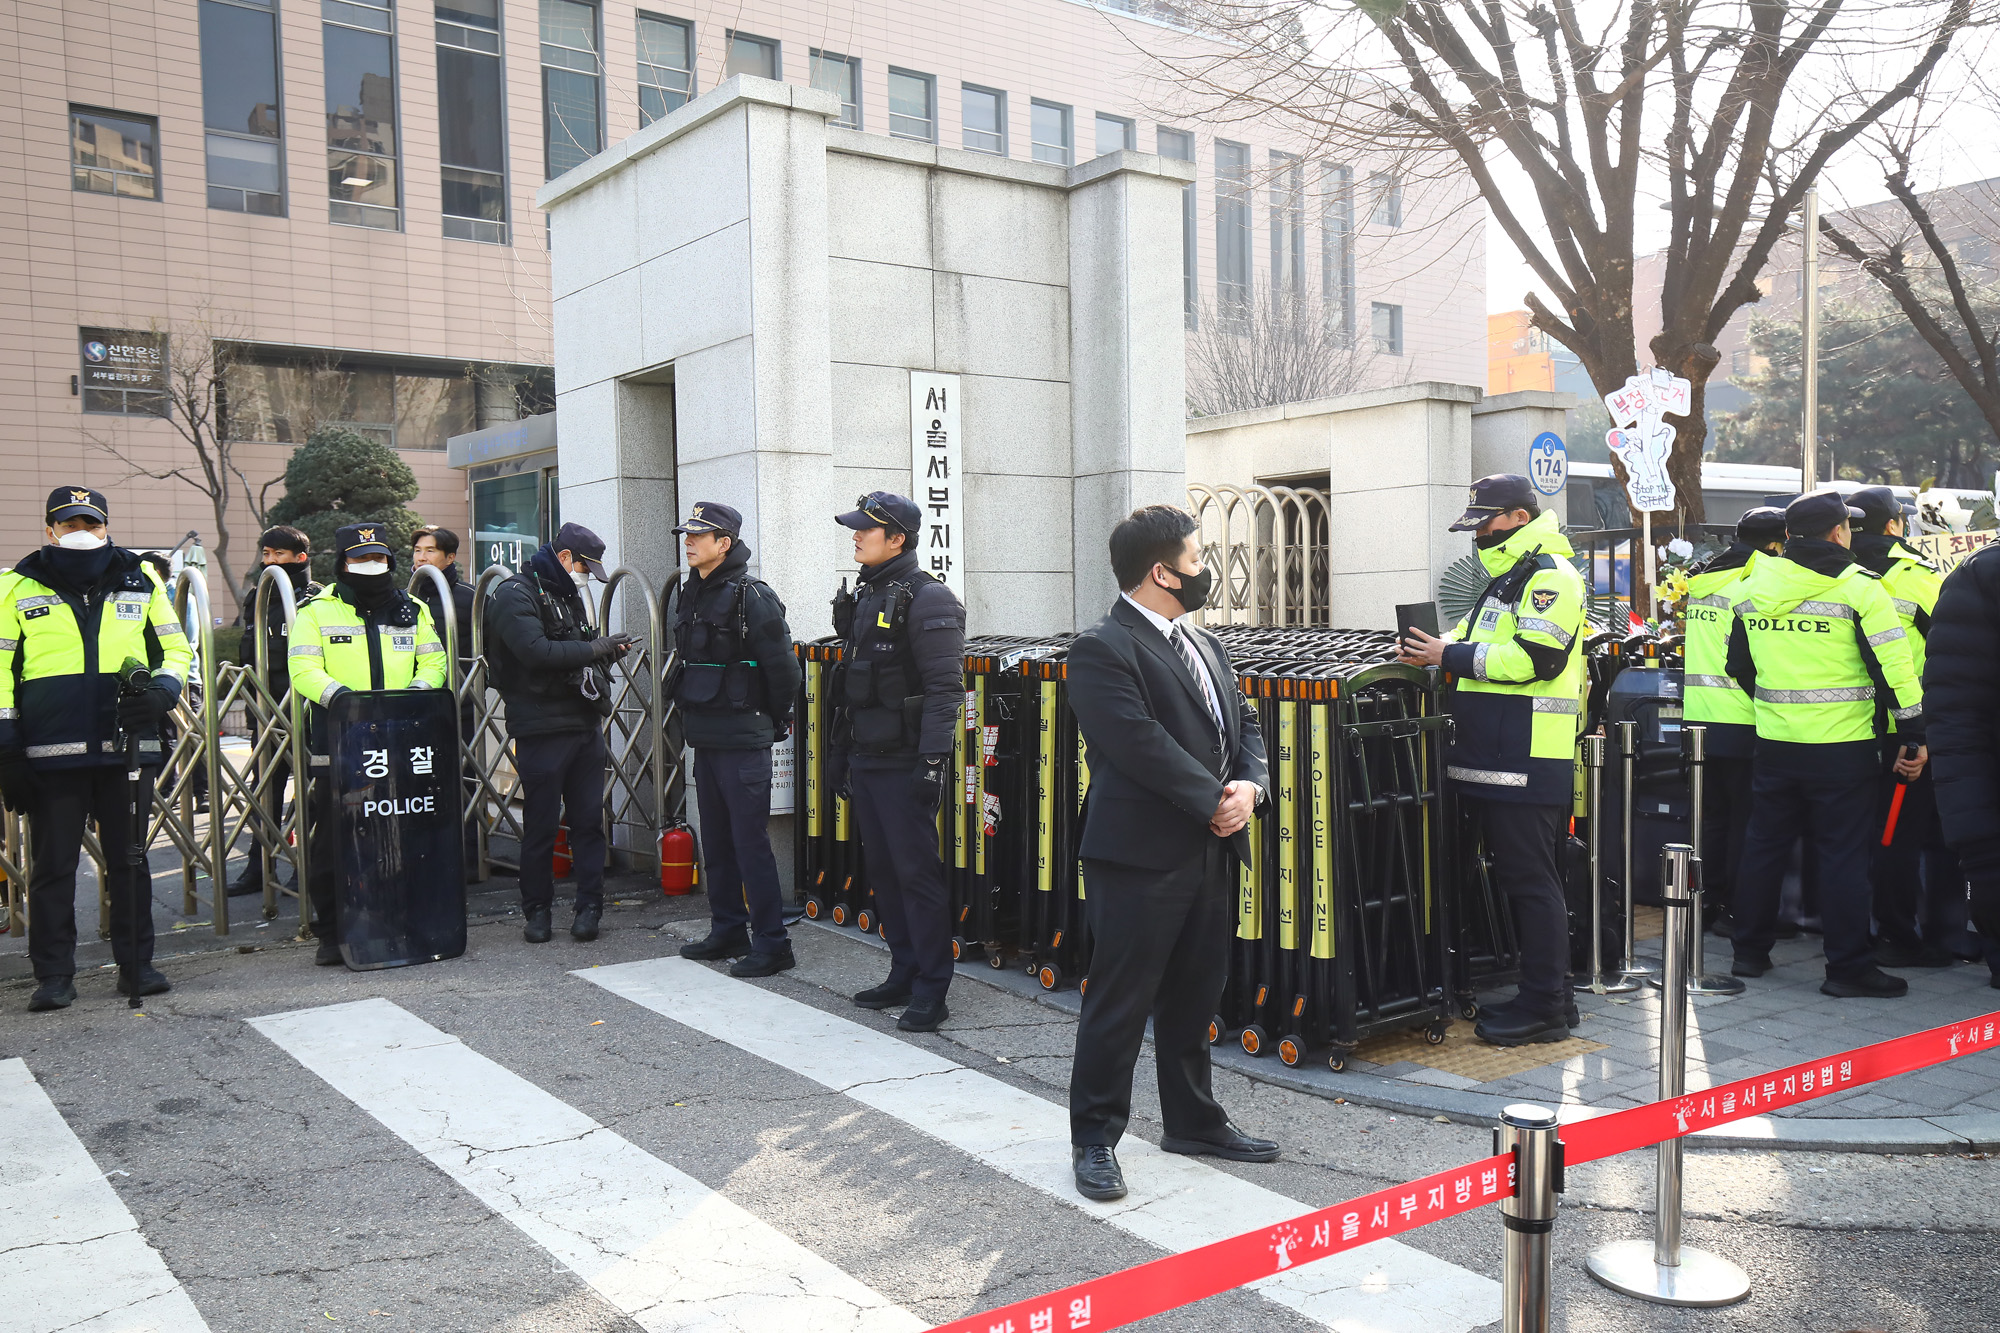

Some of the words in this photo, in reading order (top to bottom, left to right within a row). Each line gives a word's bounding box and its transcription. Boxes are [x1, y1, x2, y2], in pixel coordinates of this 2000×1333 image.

[108, 345, 160, 360] 신한은행
[1613, 389, 1646, 416] 부정
[1535, 458, 1562, 477] 174
[925, 387, 952, 585] 서울서부지방
[1639, 494, 1671, 508] STEAL
[118, 604, 140, 614] 경찰
[1686, 609, 1717, 622] LICE
[1748, 618, 1830, 633] POLICE
[394, 637, 413, 645] 경찰
[363, 796, 435, 818] POLICE
[1312, 751, 1324, 849] POLICE
[1279, 746, 1293, 925] 질서유지선
[1243, 869, 1252, 914] INE
[1316, 868, 1327, 933] LINE
[1967, 1022, 2000, 1044] 서울
[1700, 1060, 1852, 1119] 서울서부지방법원
